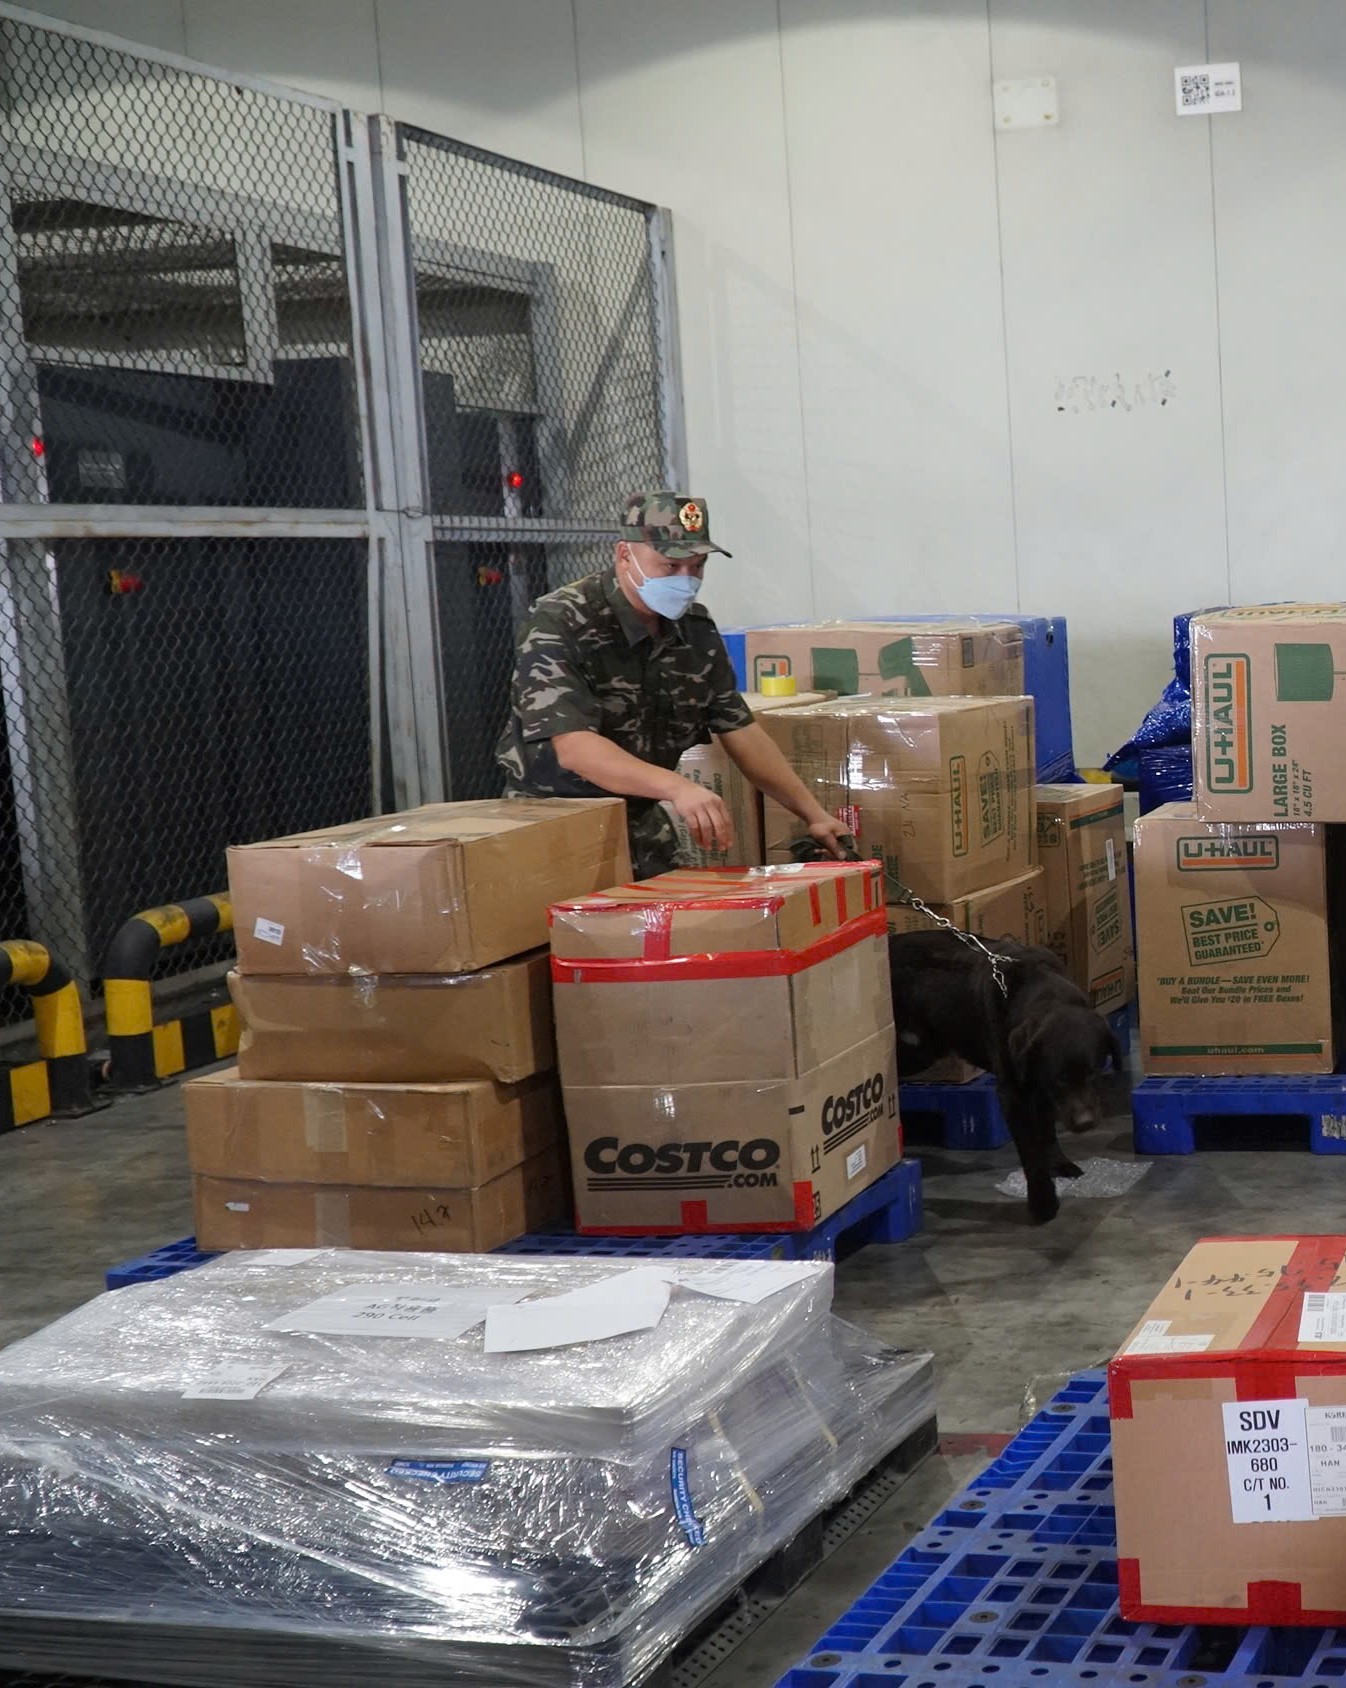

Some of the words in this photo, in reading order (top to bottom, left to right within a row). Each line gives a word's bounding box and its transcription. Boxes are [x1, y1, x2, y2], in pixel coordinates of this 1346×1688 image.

[1213, 662, 1235, 784] U-HAUL
[1271, 723, 1287, 757] BOX
[1302, 769, 1312, 784] FT
[1272, 763, 1289, 818] LARGE
[1303, 785, 1313, 799] CU
[1303, 800, 1313, 817] 4.5
[1183, 841, 1272, 858] U-HAUL
[1189, 903, 1257, 928] SAVE!
[1193, 932, 1221, 948] BEST
[1224, 928, 1259, 943] PRICE
[1257, 975, 1279, 984] EVEN
[1281, 975, 1310, 984] MORE!
[1253, 995, 1274, 1003] FREE
[1207, 1046, 1265, 1054] uhaul.com
[822, 1072, 884, 1136] COSTCO
[584, 1136, 781, 1174] COSTCO
[728, 1173, 778, 1188] .COM
[1239, 1409, 1280, 1431] SDV
[1227, 1437, 1297, 1455] IMK2303-
[1309, 1444, 1327, 1453] 180
[1250, 1457, 1278, 1472] 680
[1243, 1477, 1264, 1492] C/T
[1269, 1476, 1290, 1490] NO.
[1263, 1493, 1271, 1511] 1
